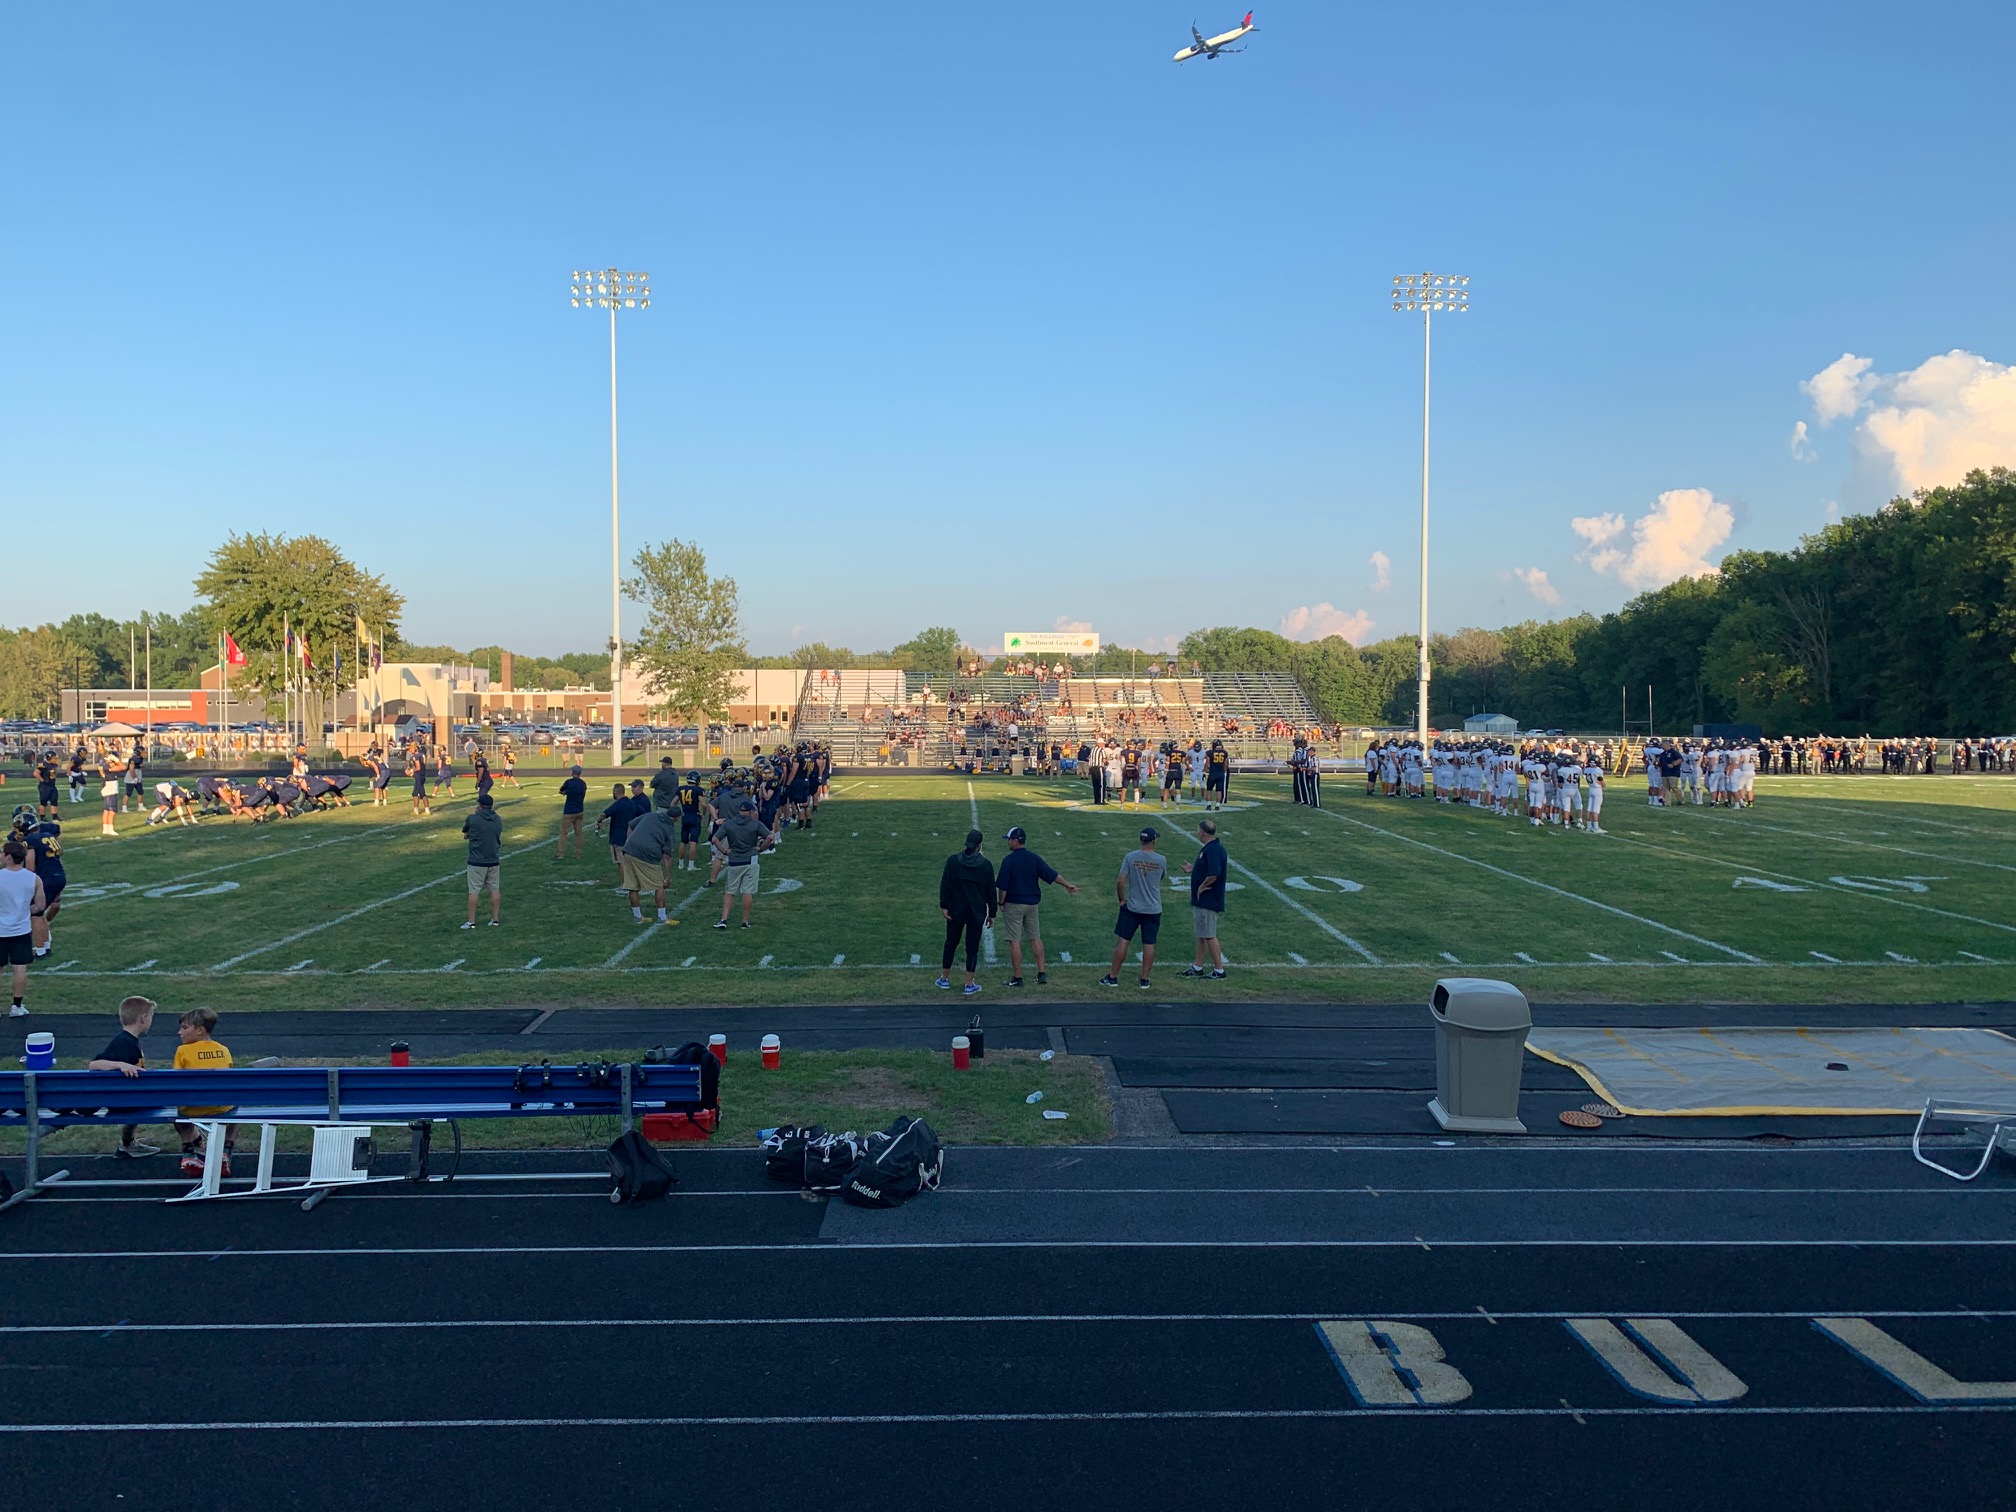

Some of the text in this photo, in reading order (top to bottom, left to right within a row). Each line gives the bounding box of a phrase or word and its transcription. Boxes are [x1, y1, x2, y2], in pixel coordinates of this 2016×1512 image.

[1109, 753, 1118, 761] 54
[1128, 753, 1135, 763] 9
[1171, 753, 1181, 762] 25
[1213, 752, 1224, 763] 56
[1504, 760, 1514, 770] 14
[1566, 773, 1579, 784] 45
[680, 789, 693, 804] 14
